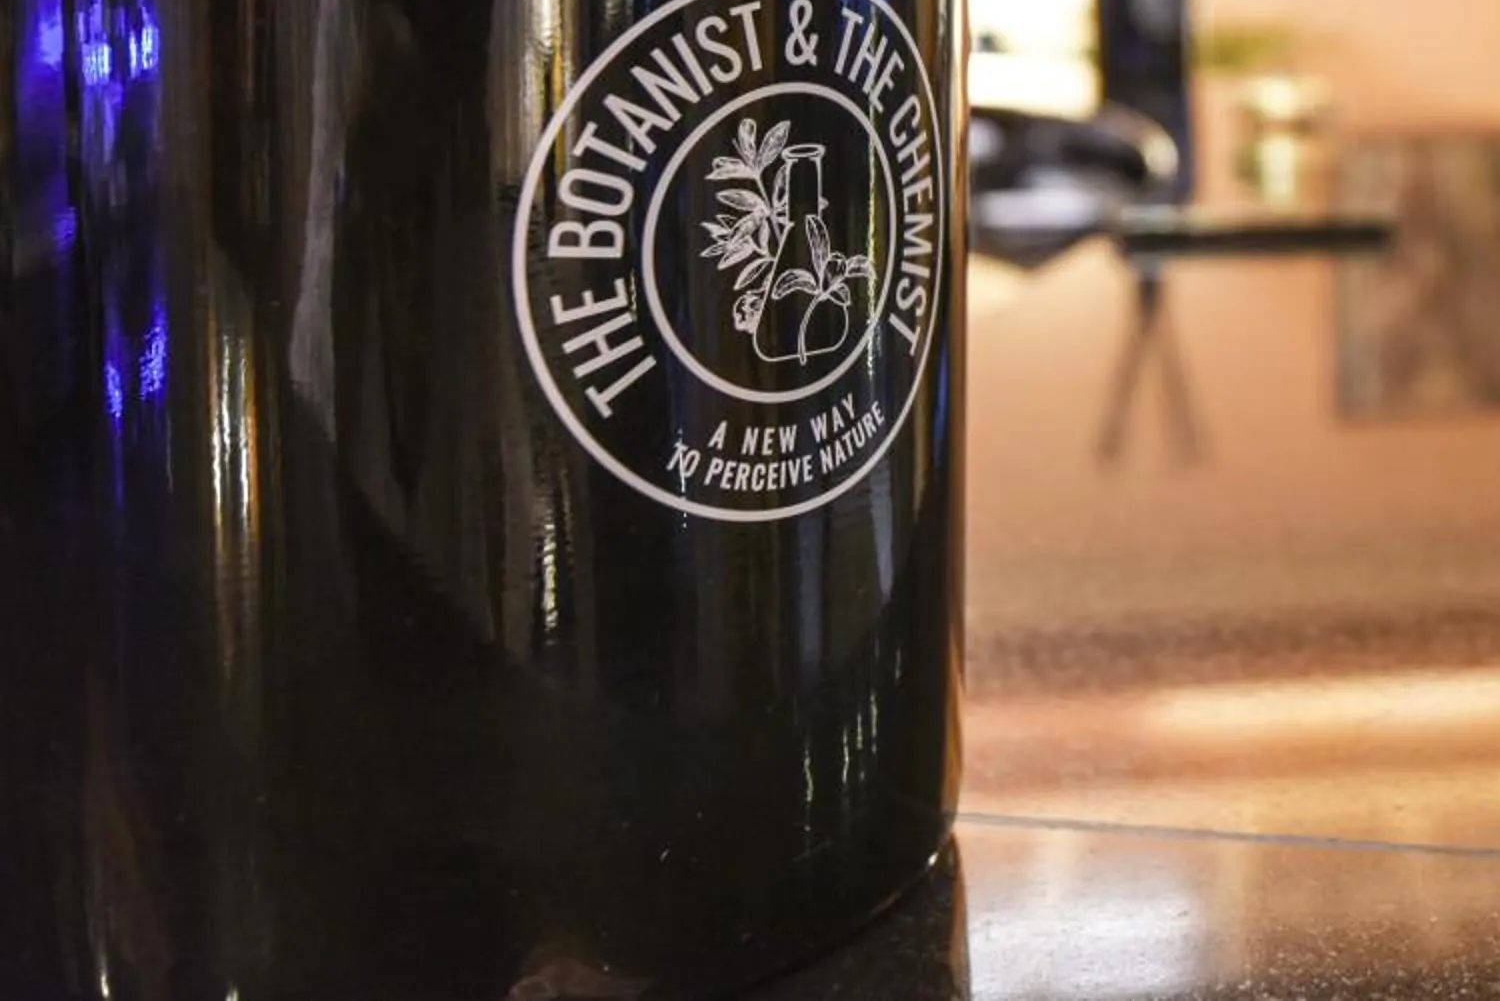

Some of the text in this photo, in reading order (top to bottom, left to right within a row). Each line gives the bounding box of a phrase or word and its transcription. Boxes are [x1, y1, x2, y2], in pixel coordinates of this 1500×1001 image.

[833, 7, 905, 113] THE
[547, 0, 762, 260] BOTANIST
[889, 93, 933, 356] CHEMIST
[550, 277, 657, 418] THE
[667, 400, 885, 492] TO PERCEIVE NATURE
[707, 393, 856, 455] A NEW WAY
